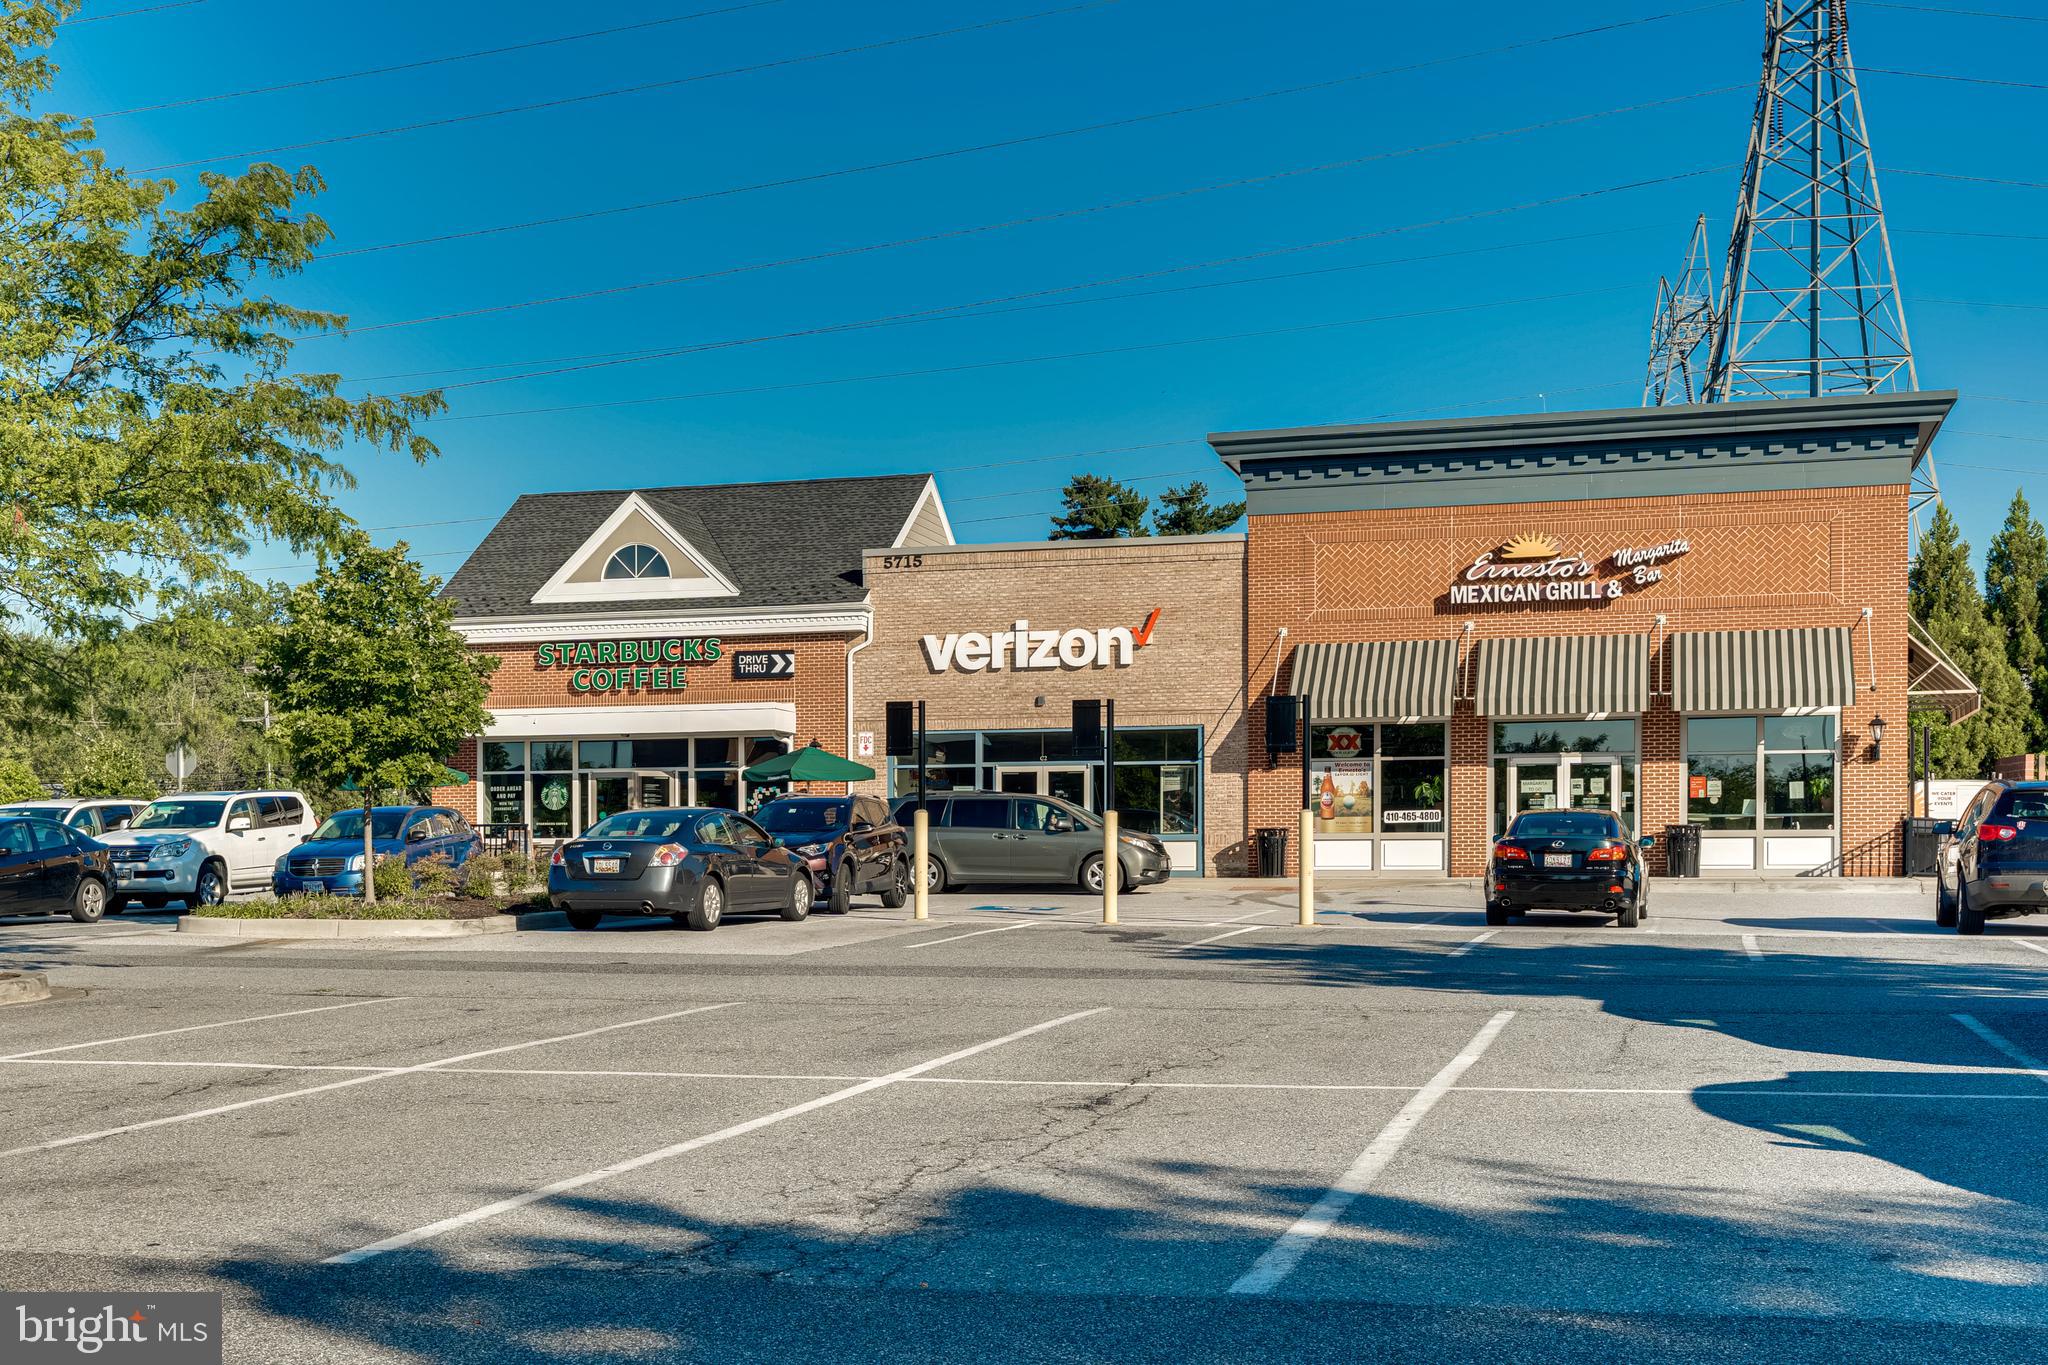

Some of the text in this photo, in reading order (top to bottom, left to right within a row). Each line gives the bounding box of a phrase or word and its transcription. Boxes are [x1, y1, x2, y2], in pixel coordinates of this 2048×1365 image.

[883, 555, 922, 570] 5715
[1613, 539, 1691, 567] Margarita
[1466, 551, 1594, 580] Ernesto's
[1633, 565, 1662, 585] Bar
[1451, 579, 1623, 604] MEXICAN GRILL &
[538, 638, 722, 666] STARBUCKS
[923, 619, 1134, 672] verizon
[738, 654, 768, 664] DRIVE
[739, 664, 767, 673] THRU
[573, 667, 687, 690] COFFEE
[860, 735, 872, 744] FDC
[1327, 733, 1361, 750] XX
[1386, 811, 1440, 821] 410-465-4800
